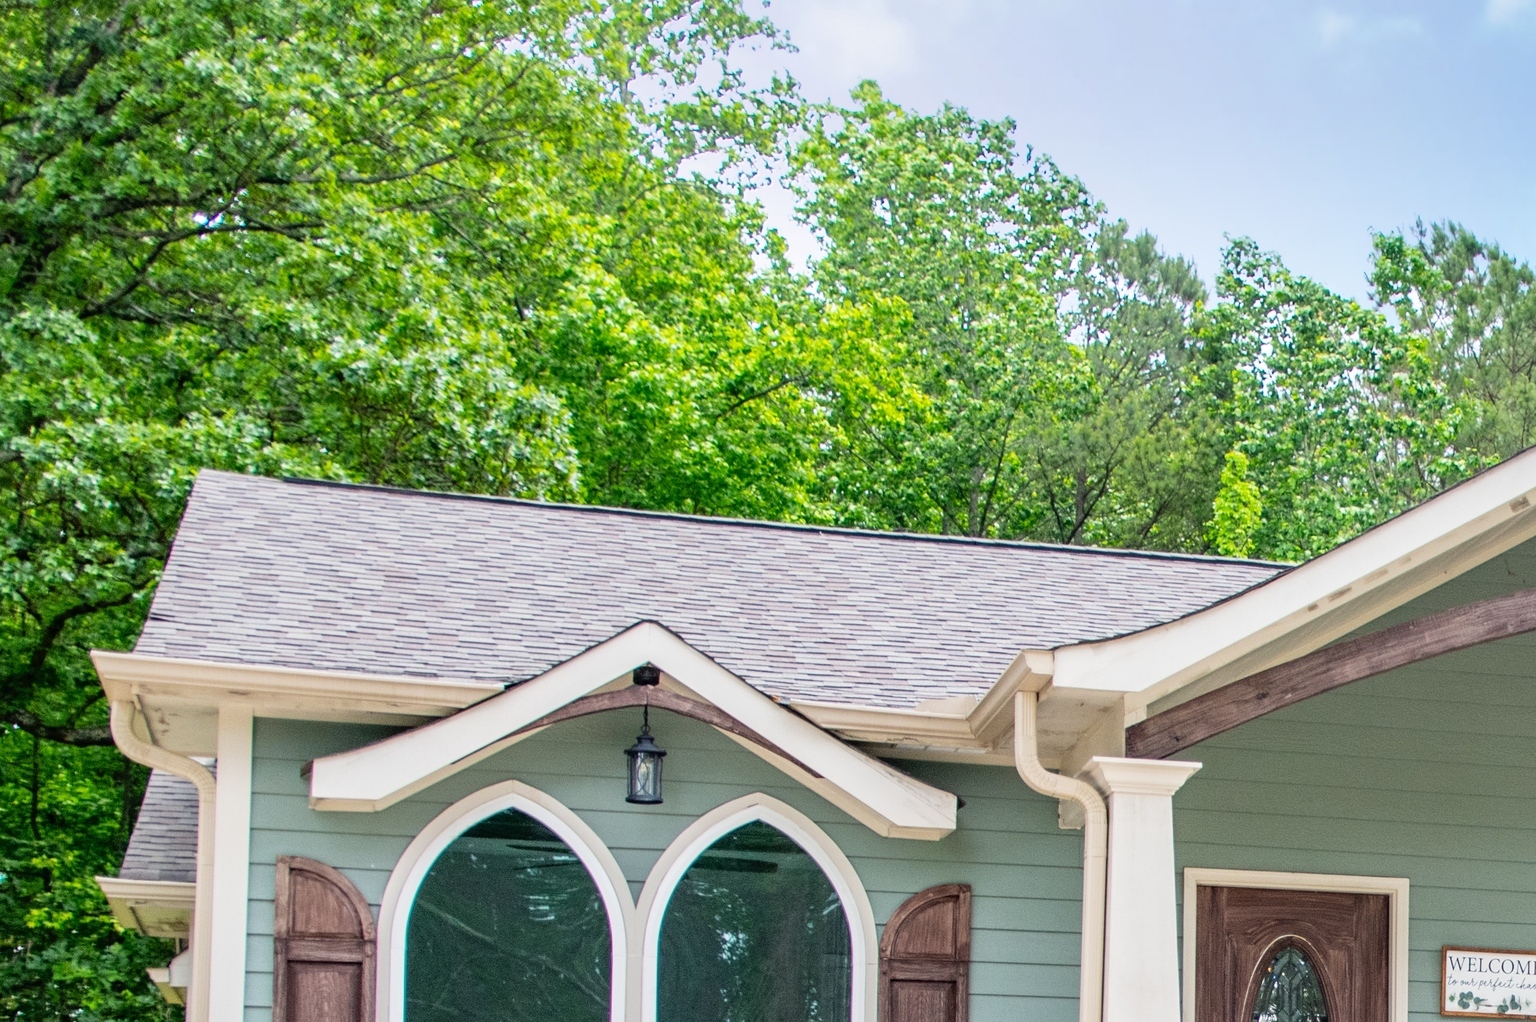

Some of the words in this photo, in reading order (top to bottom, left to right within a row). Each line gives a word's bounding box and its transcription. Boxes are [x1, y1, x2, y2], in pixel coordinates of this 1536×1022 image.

[1447, 974, 1457, 986] to
[1460, 977, 1477, 986] our
[1478, 977, 1514, 991] perfect
